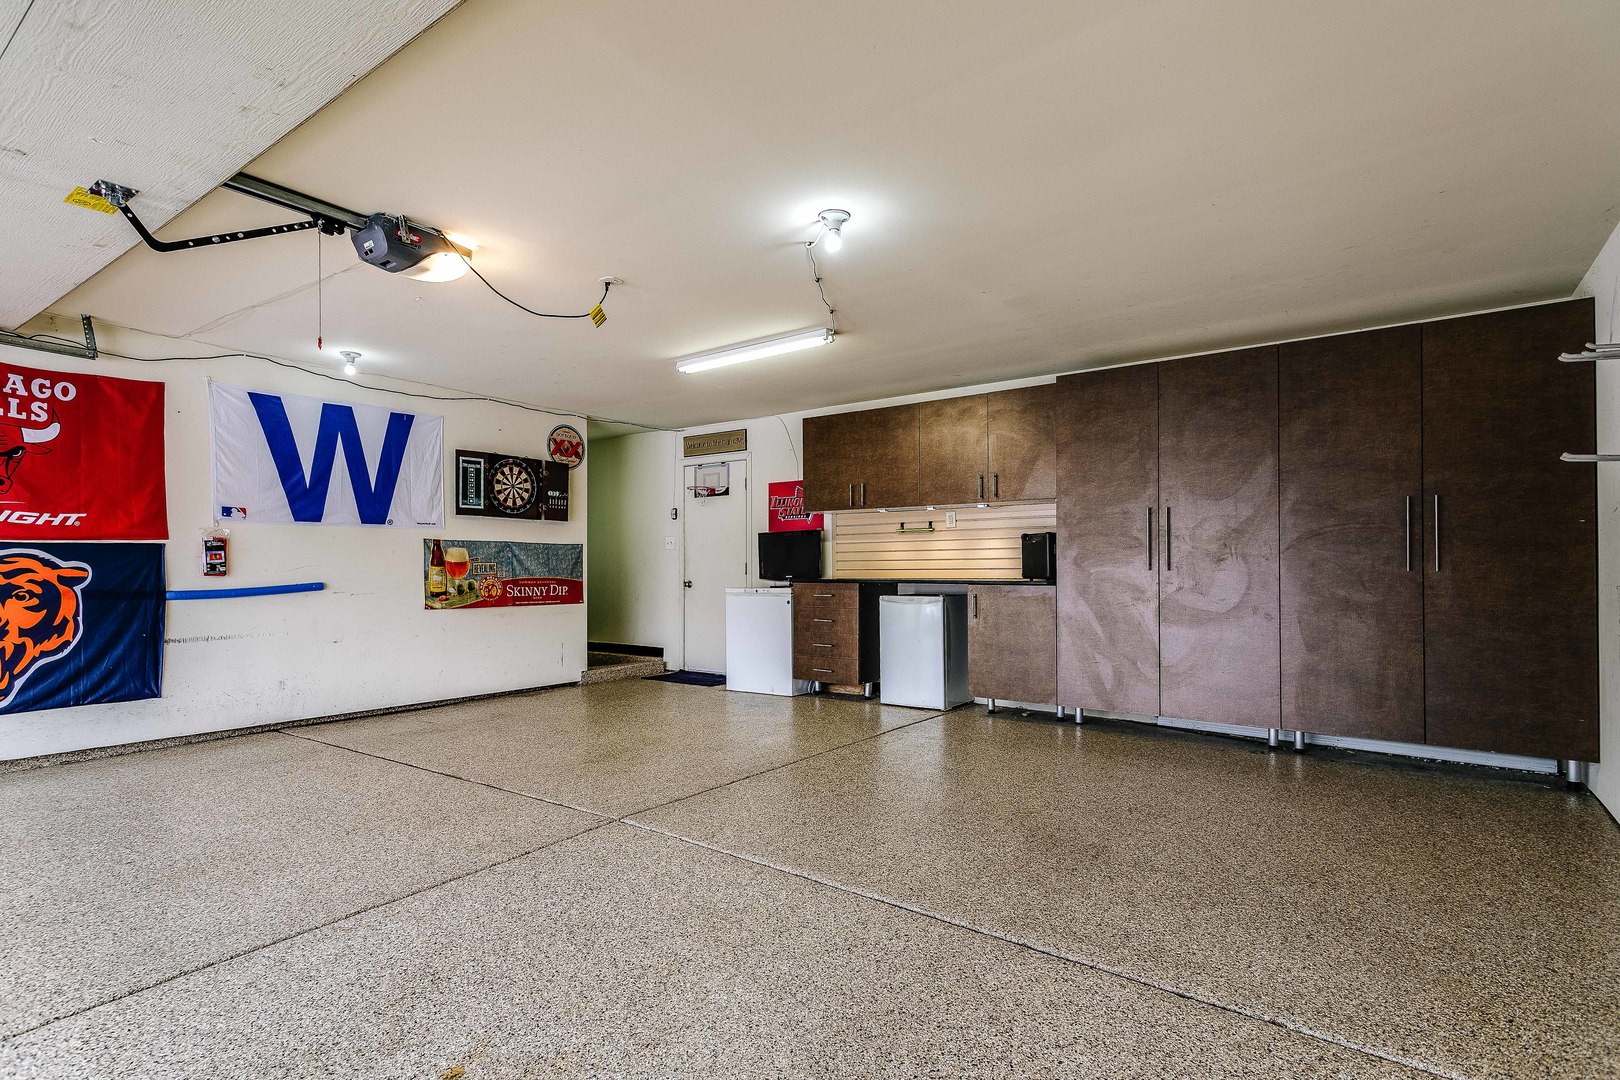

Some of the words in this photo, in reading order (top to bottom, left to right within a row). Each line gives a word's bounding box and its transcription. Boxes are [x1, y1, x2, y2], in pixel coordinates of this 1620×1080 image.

[0, 397, 49, 422] LS
[247, 391, 415, 524] W
[506, 584, 548, 597] SKINNY
